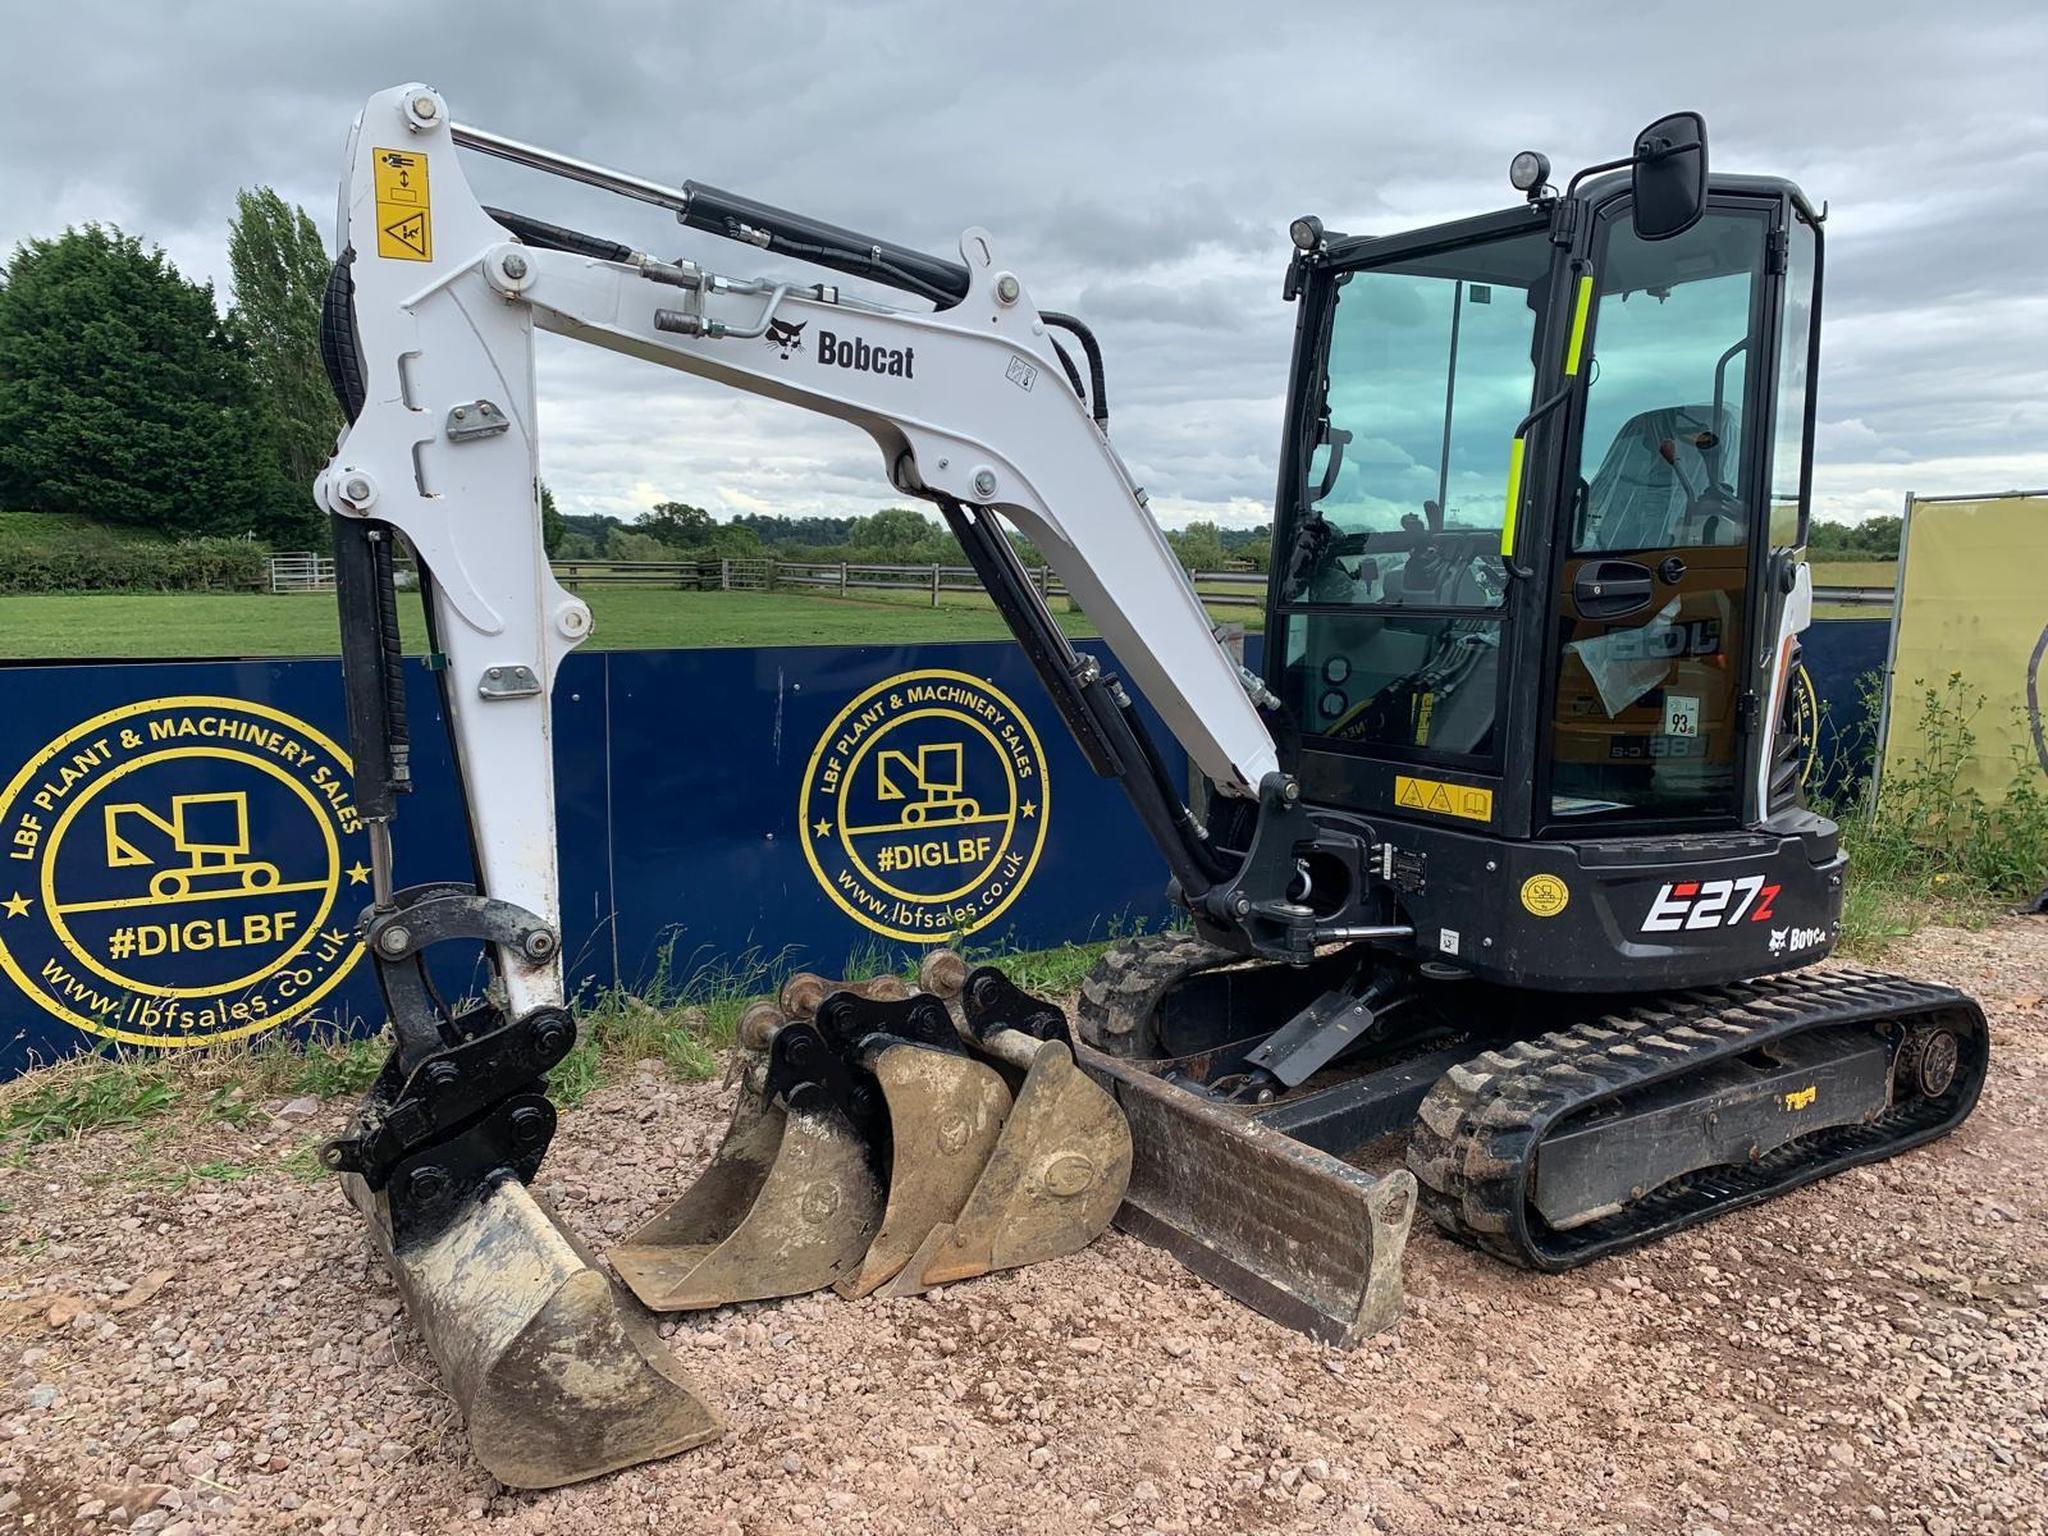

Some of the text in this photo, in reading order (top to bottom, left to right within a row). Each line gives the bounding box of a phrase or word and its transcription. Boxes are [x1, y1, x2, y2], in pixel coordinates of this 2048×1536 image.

[817, 330, 914, 379] Bobcat
[820, 685, 1033, 794] LBF PLANT & MACHINERY SALES
[1672, 713, 1688, 733] 93
[10, 715, 363, 860] LBF PLANT & MACHINERY SALES
[877, 836, 991, 872] #DIGLBF
[838, 851, 1024, 928] www.lbfsales.co.uk
[108, 911, 297, 960] #DIGLBF
[41, 926, 350, 1029] www.lbfsales.co.uk
